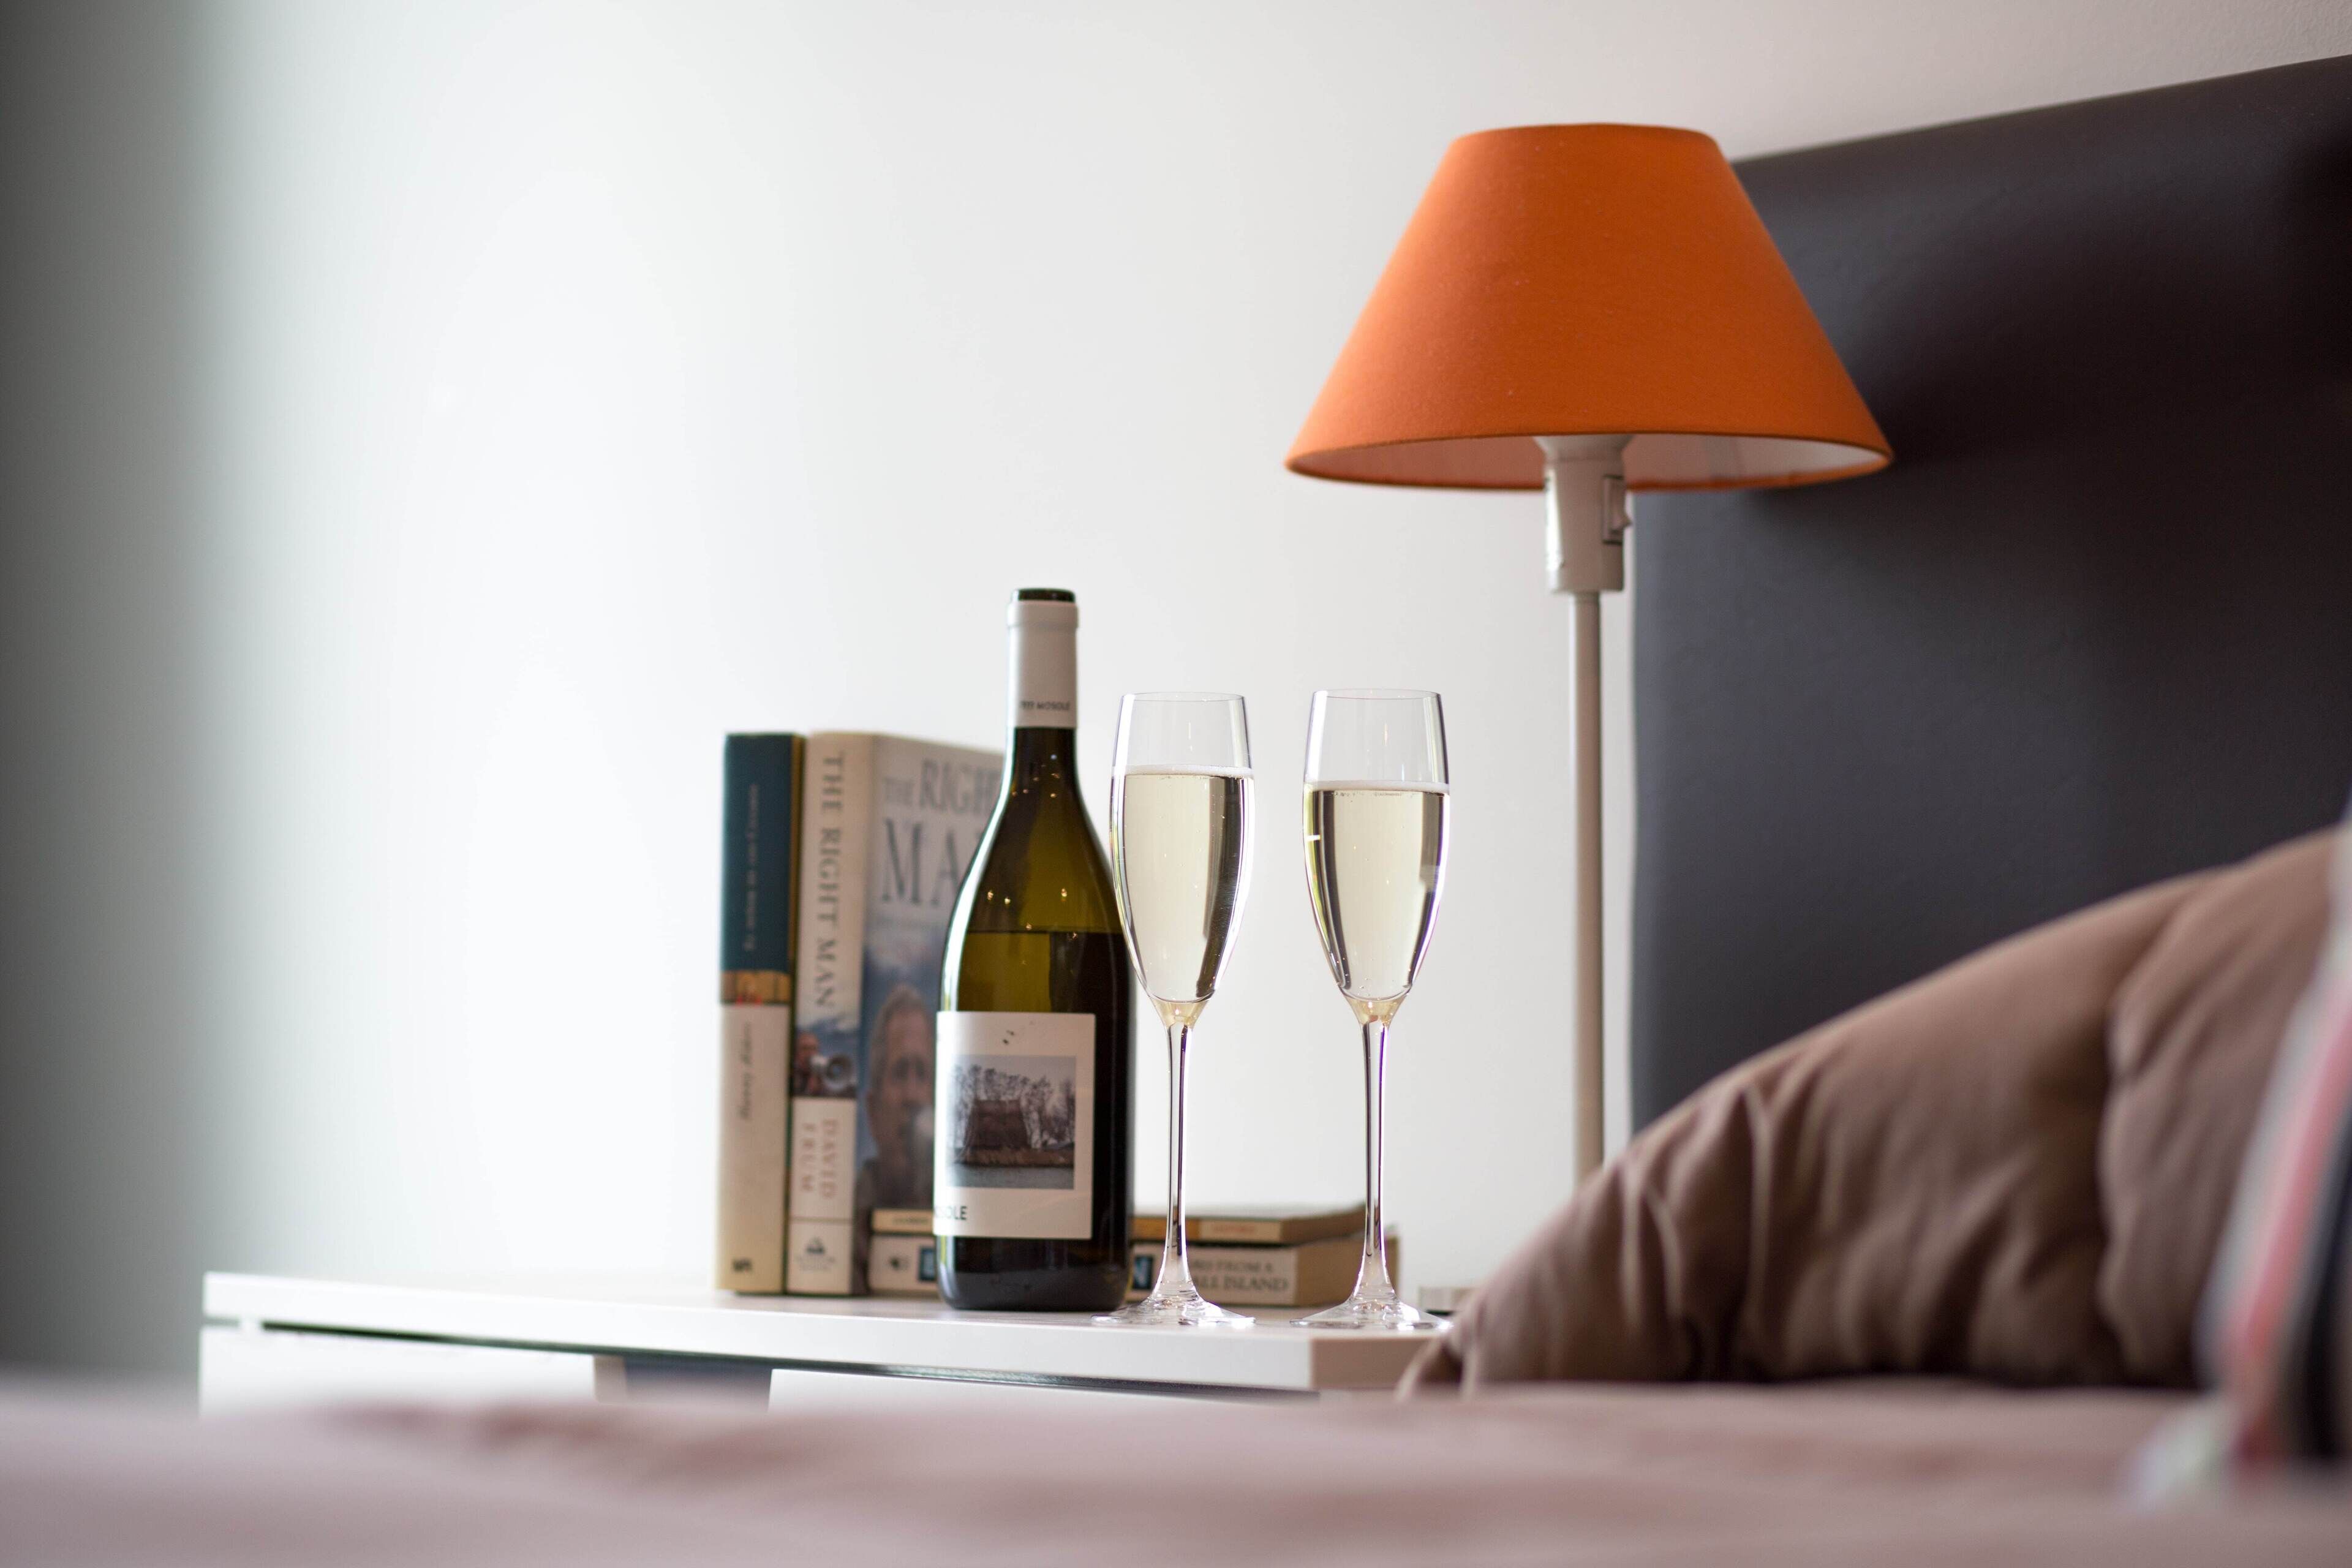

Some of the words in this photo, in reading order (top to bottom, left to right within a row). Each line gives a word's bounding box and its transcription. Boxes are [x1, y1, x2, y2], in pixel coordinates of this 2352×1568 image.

[822, 752, 844, 813] THE
[919, 758, 1001, 815] RIGH
[818, 828, 843, 924] RIGHT
[881, 817, 984, 907] MA
[813, 938, 837, 1008] MAN
[820, 1118, 839, 1199] DAVID
[1223, 1275, 1290, 1292] ISLAND
